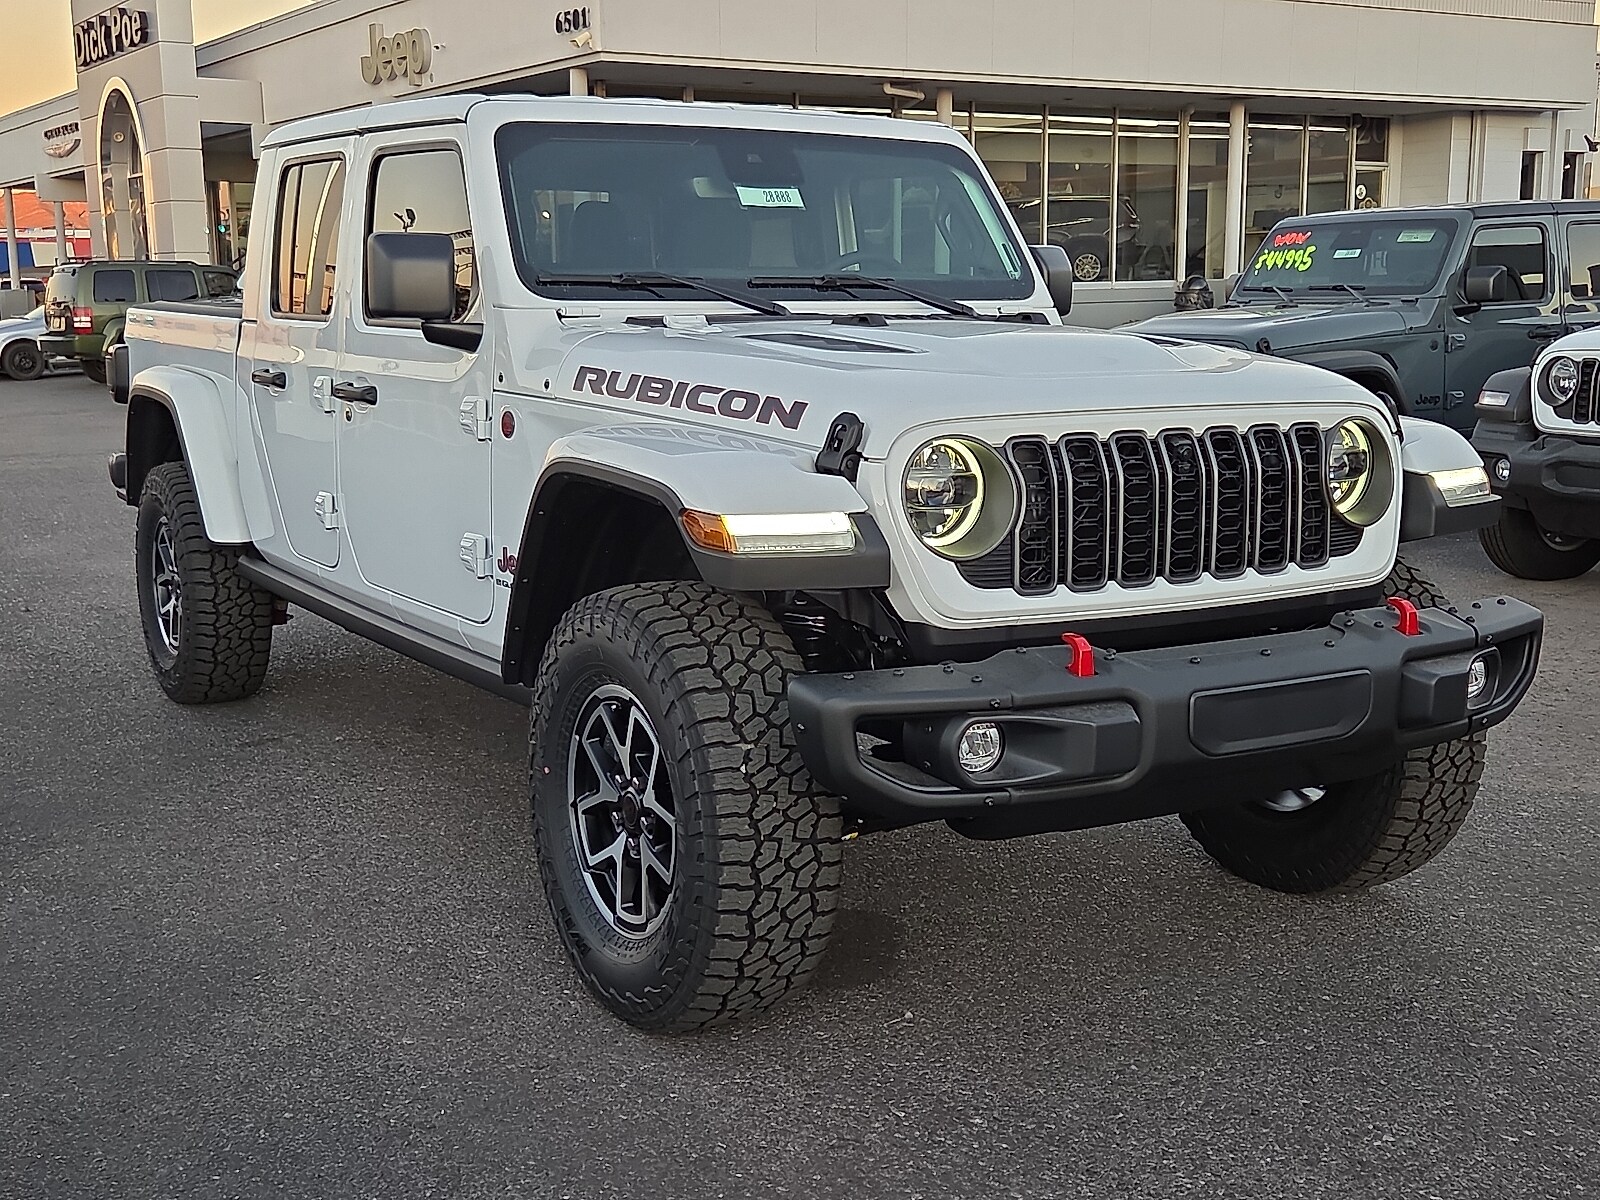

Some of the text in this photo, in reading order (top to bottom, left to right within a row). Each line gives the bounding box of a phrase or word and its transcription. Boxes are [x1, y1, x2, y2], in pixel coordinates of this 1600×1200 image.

[74, 8, 147, 67] Dick Poe
[555, 6, 588, 33] 6501
[361, 24, 432, 87] Jeep
[572, 365, 809, 430] RUBICON
